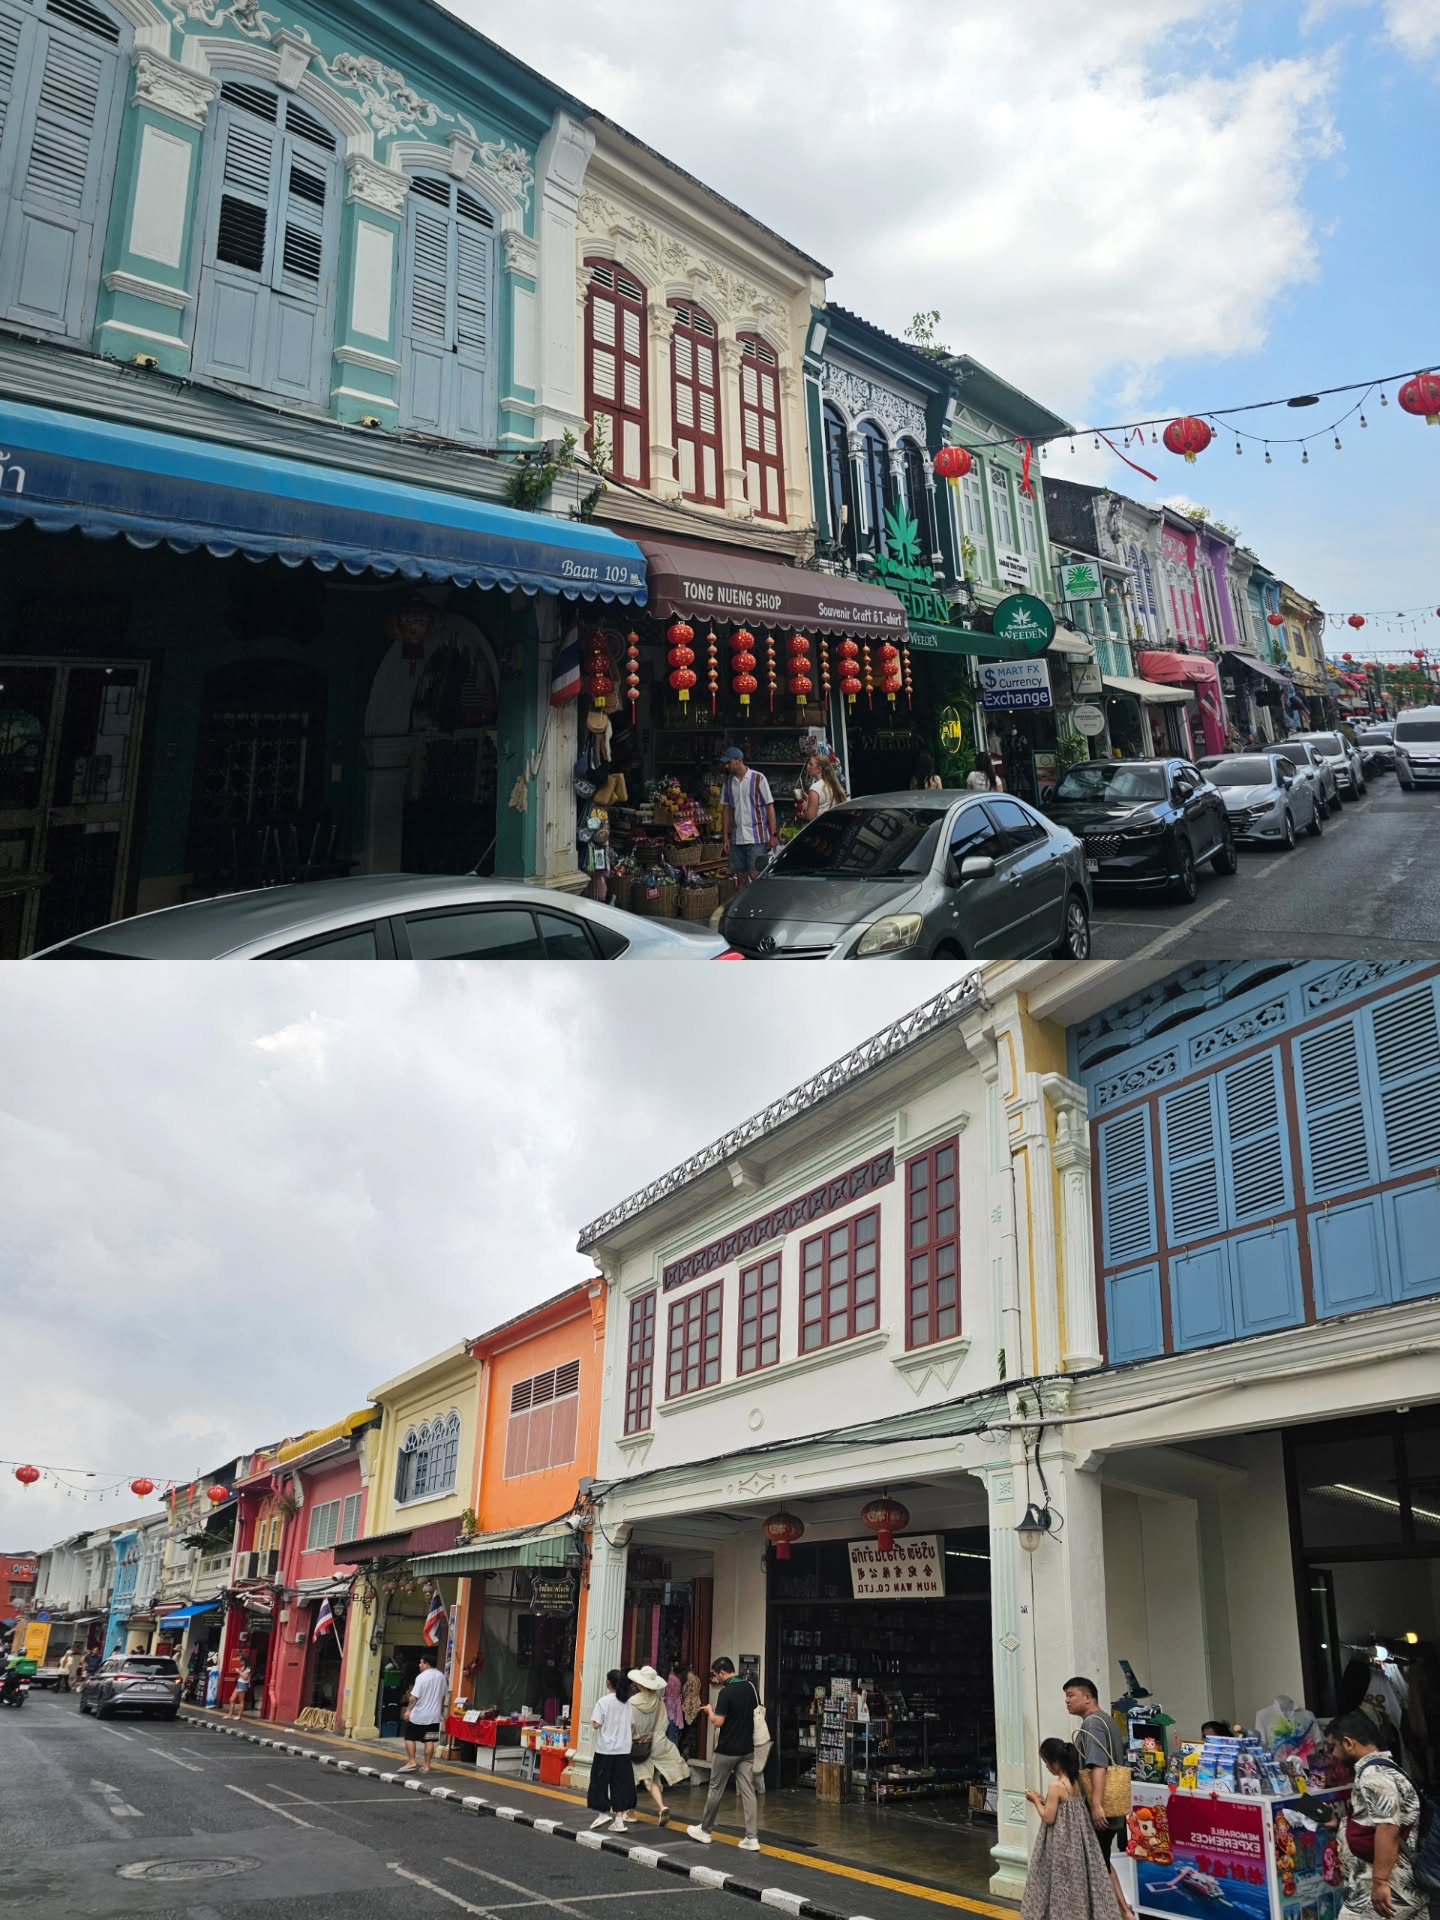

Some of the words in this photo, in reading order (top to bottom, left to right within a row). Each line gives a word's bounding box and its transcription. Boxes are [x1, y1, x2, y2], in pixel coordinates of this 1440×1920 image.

[561, 560, 599, 579] Baan
[604, 565, 628, 582] 109
[682, 581, 713, 601] TONG
[717, 586, 753, 607] NUENG
[755, 592, 782, 610] SHOP
[817, 602, 851, 620] Souvenir
[852, 607, 872, 622] Craft
[872, 610, 878, 623] &
[878, 610, 902, 626] T-shirt
[909, 632, 938, 647] WEEDEN
[999, 627, 1048, 640] WEEDEN
[1027, 664, 1040, 673] FX
[999, 677, 1042, 689] Currency
[984, 691, 1048, 707] Exchange
